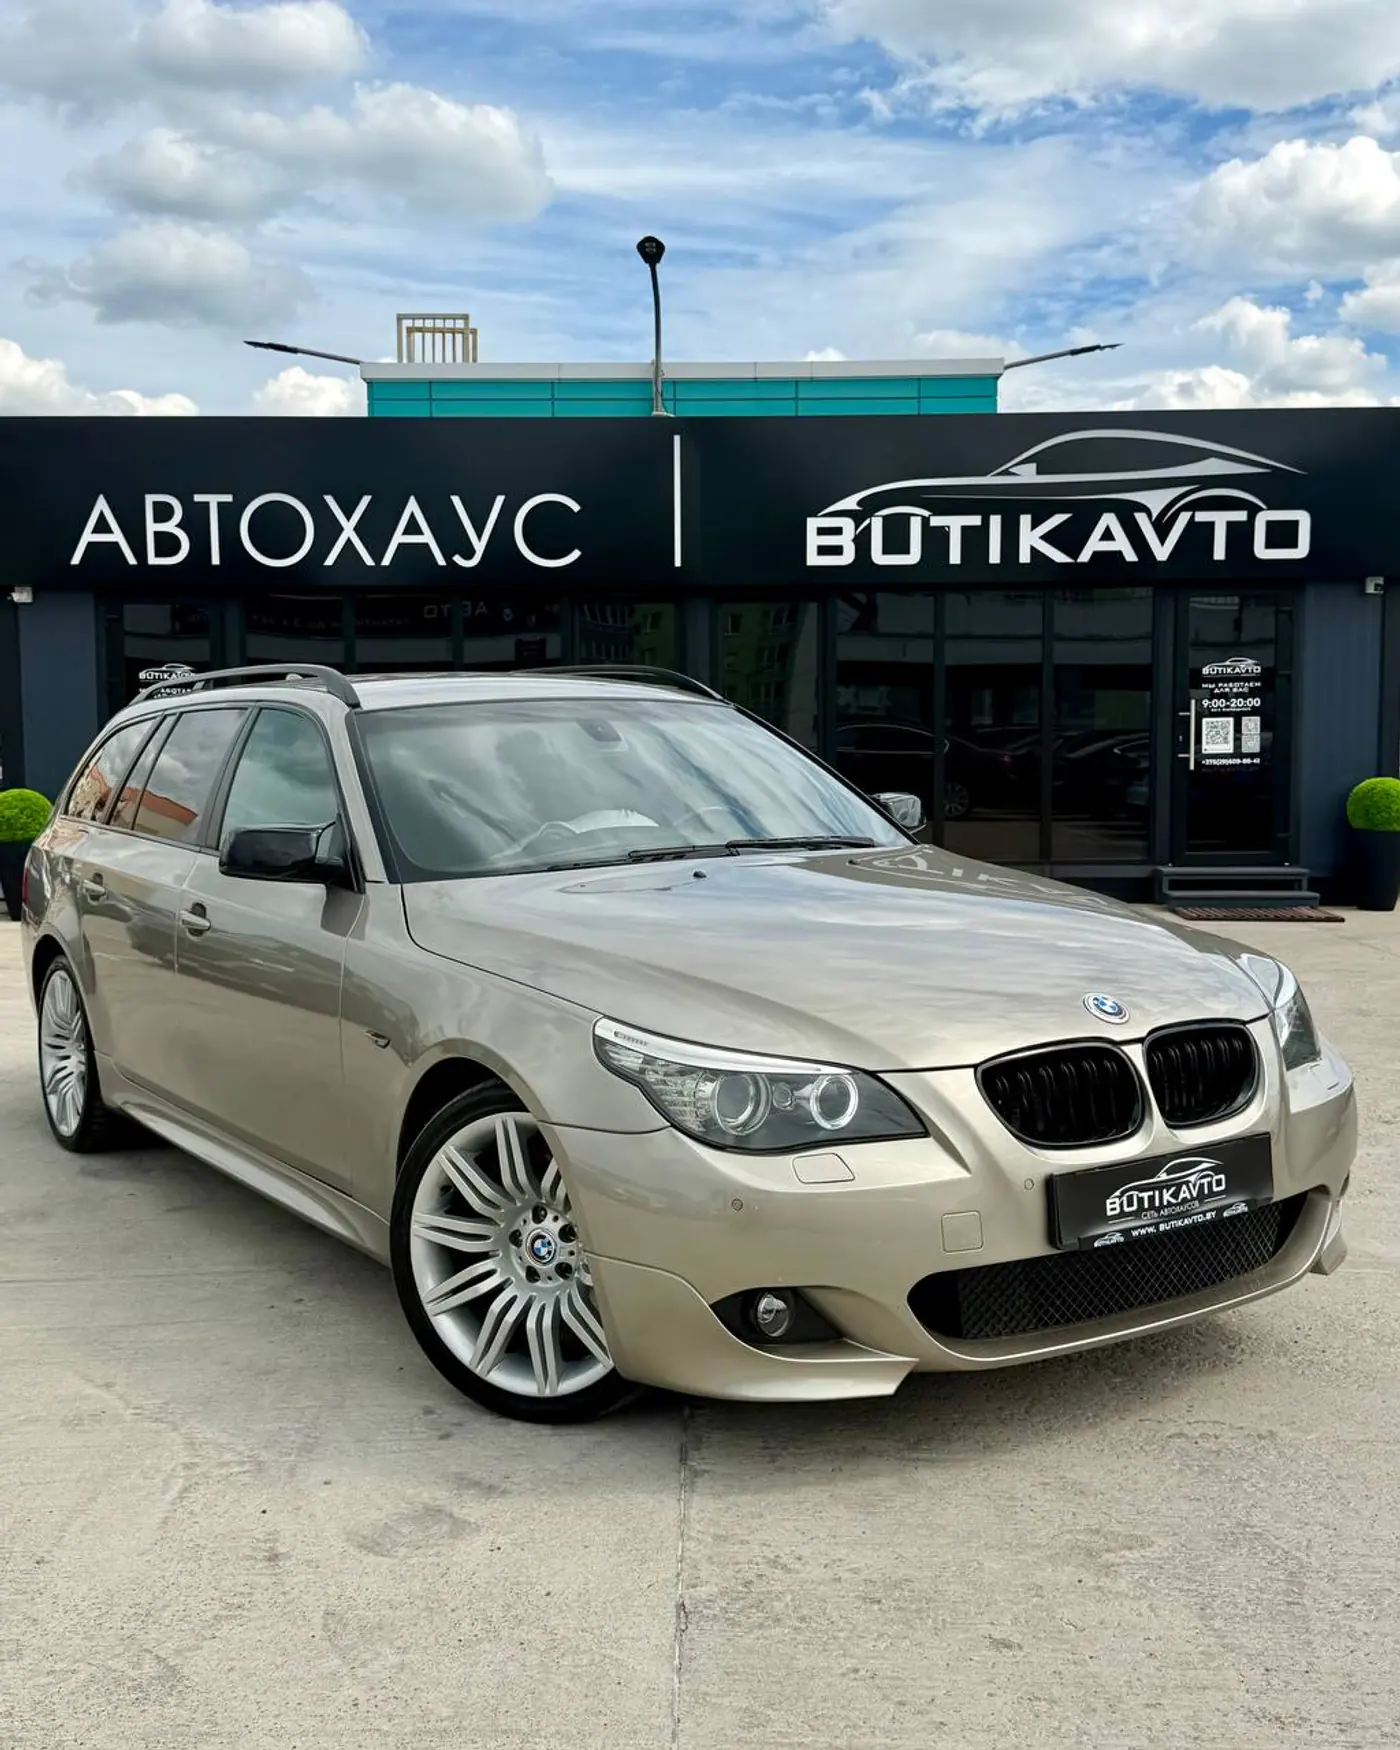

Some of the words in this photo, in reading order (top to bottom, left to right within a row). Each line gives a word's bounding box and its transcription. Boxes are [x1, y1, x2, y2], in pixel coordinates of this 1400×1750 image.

[70, 492, 582, 568] АВТОХАУС
[805, 508, 1312, 567] BUTIKAVTO
[1202, 665, 1261, 675] BUTIKAVTO
[1201, 697, 1261, 708] 9:00-20:00
[1105, 1173, 1227, 1217] BUTIKAVTO
